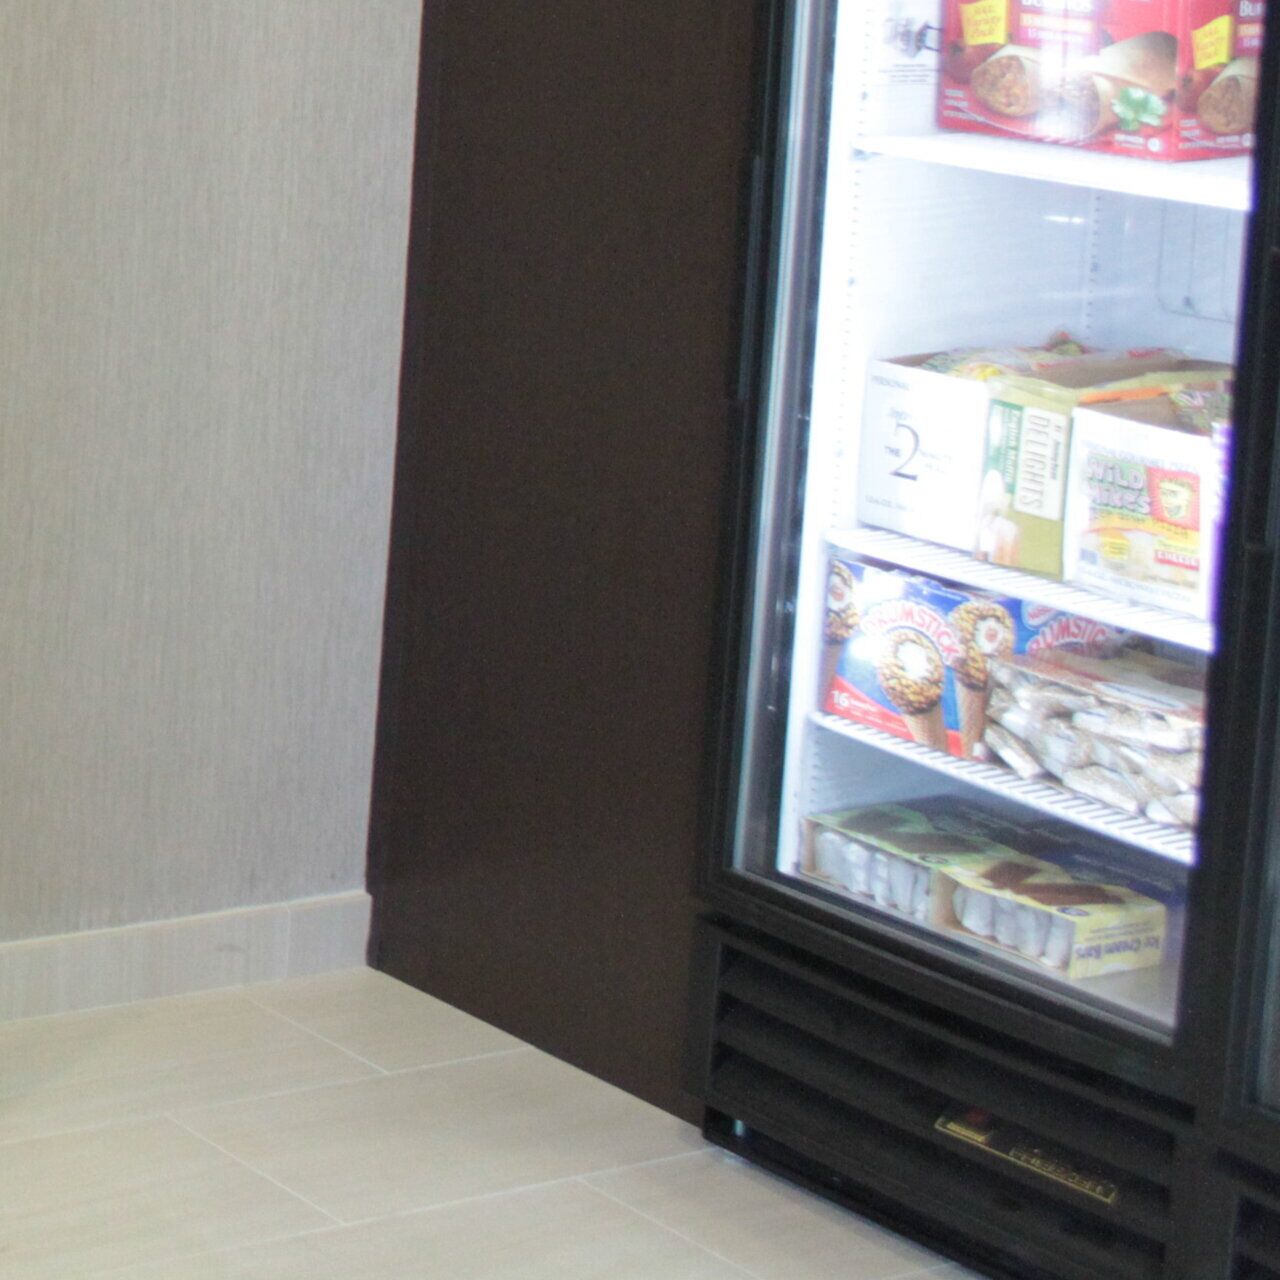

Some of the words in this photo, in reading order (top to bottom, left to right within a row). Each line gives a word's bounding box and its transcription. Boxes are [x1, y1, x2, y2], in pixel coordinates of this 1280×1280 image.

[888, 422, 921, 482] 2
[1019, 415, 1051, 510] DELIGHTS
[1087, 460, 1147, 488] WILD
[863, 602, 961, 664] DRUMSTICK
[832, 690, 850, 708] 16
